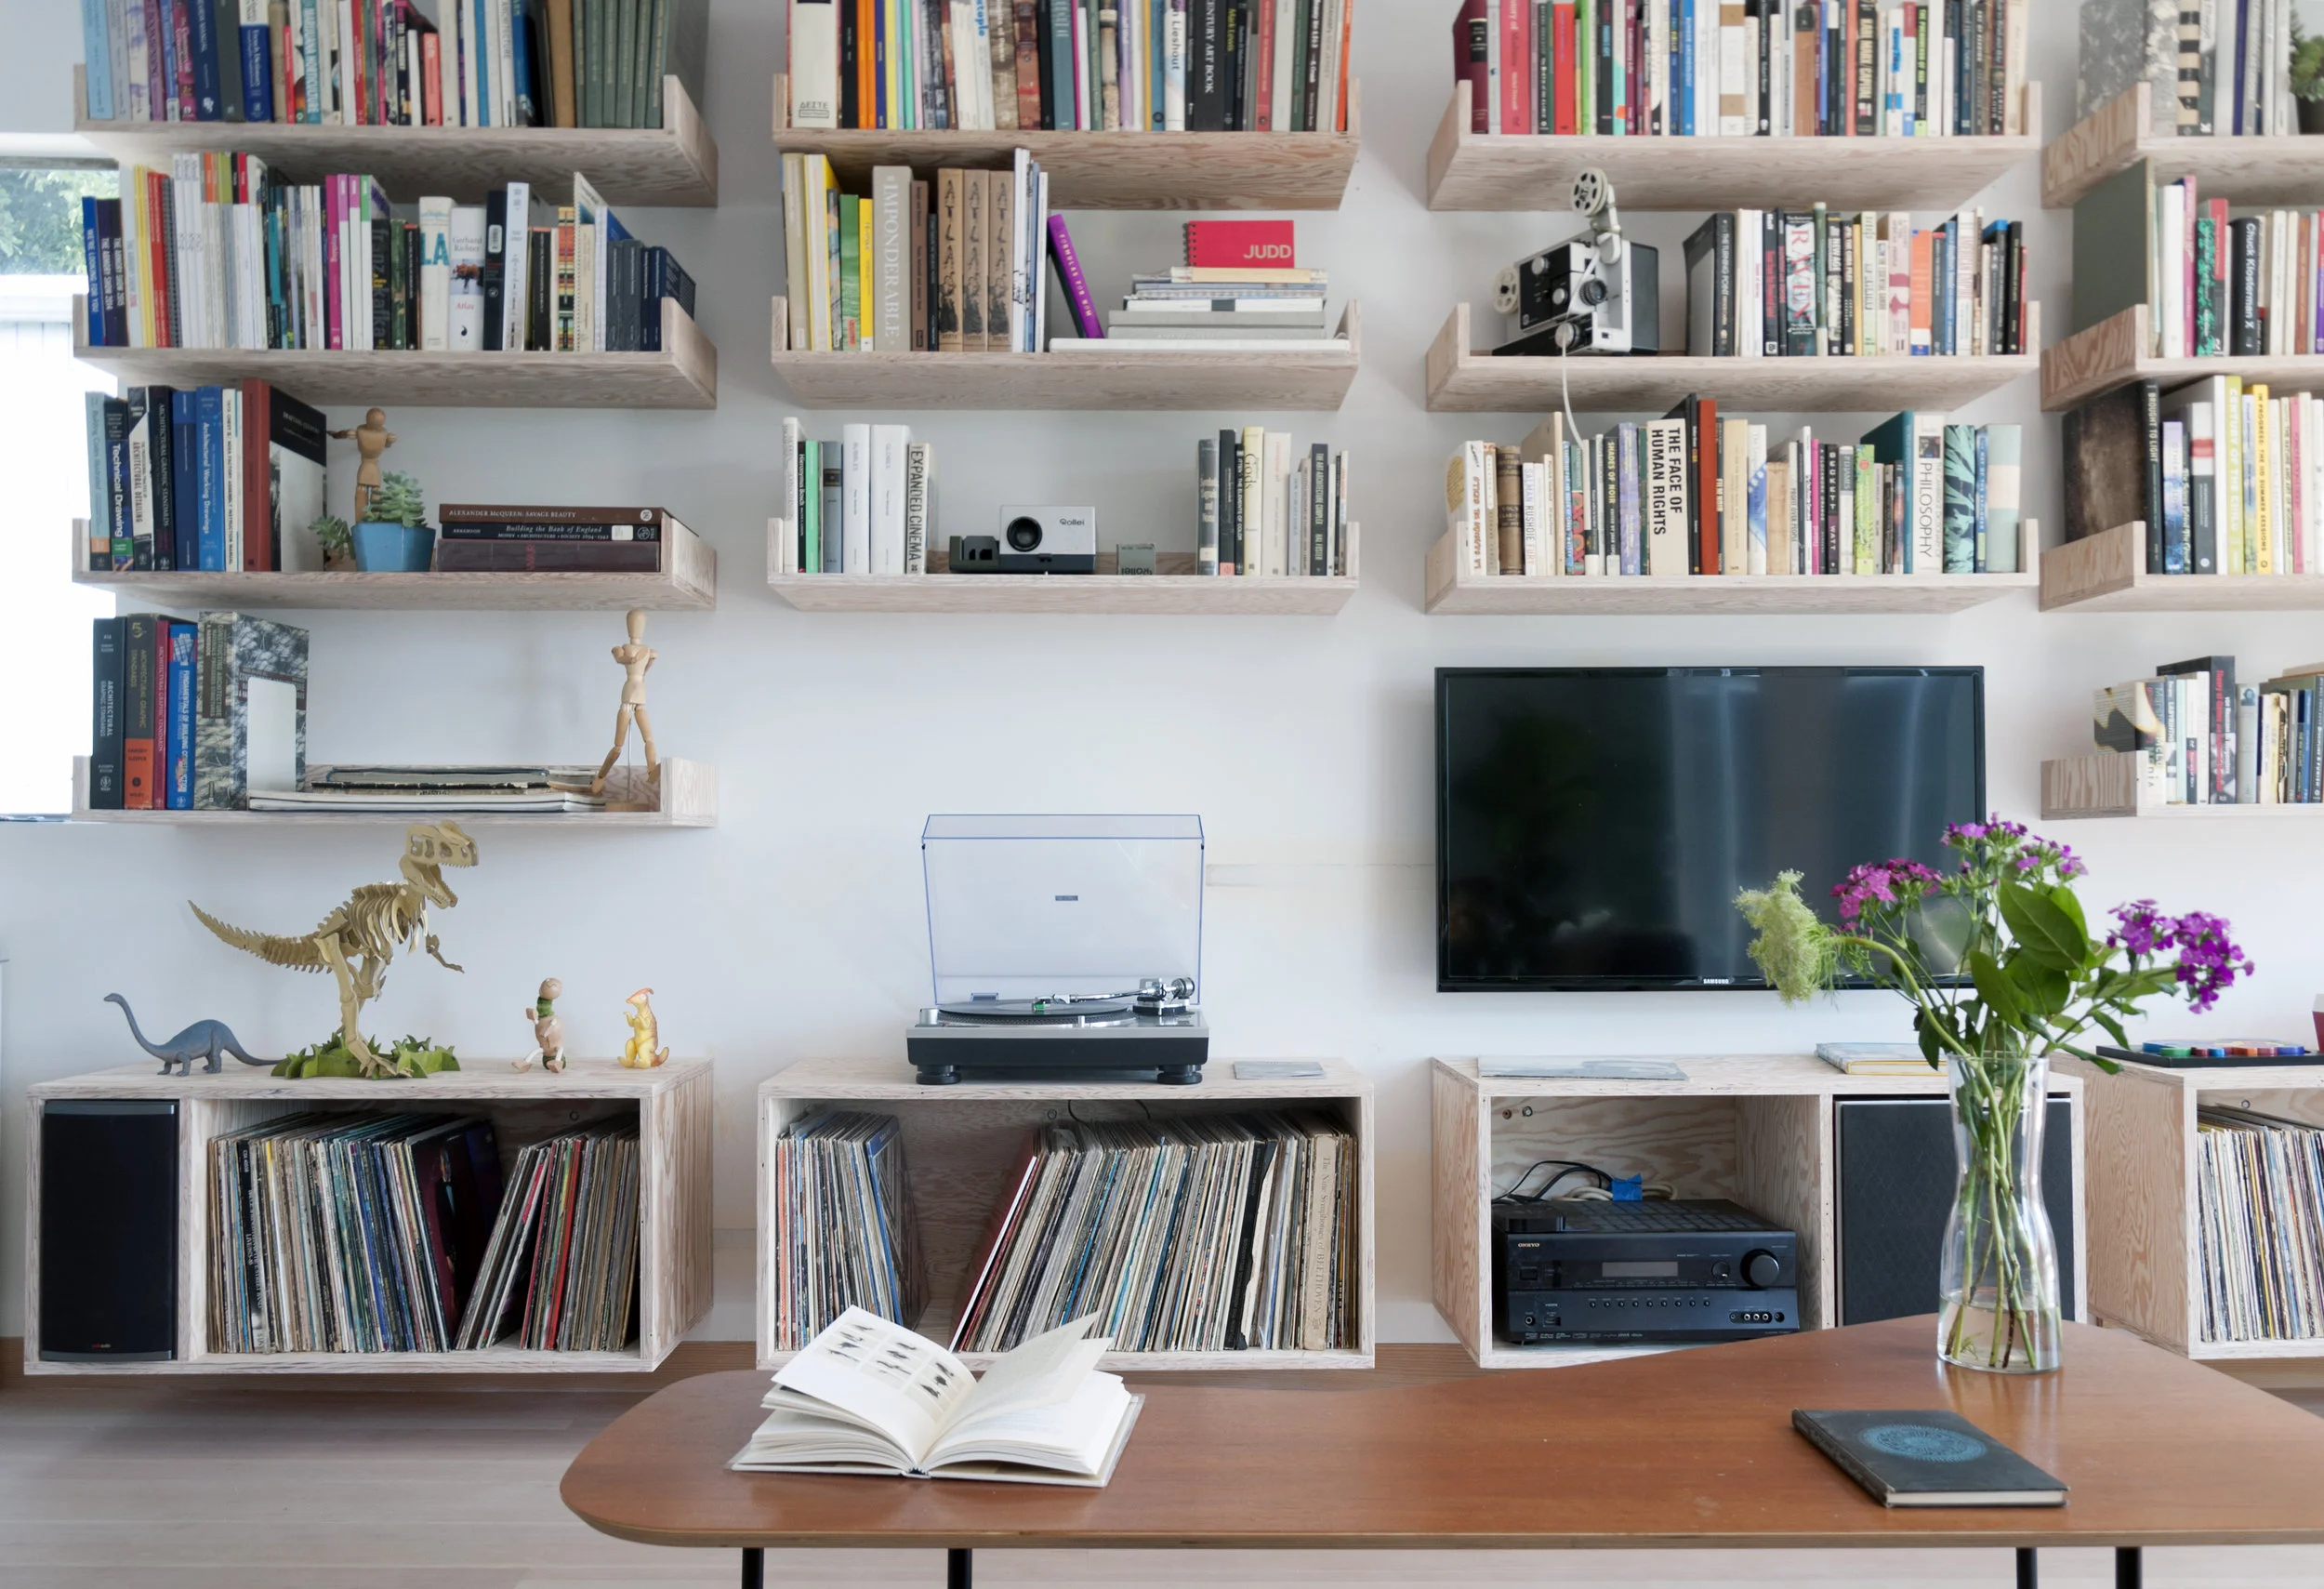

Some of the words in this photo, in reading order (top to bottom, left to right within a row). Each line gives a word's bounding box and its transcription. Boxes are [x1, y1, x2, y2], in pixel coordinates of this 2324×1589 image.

[303, 7, 316, 54] MARIJUANA
[502, 2, 511, 60] ARCHITECTURE
[1227, 8, 1236, 28] Mark
[1858, 19, 1872, 39] KARL
[1171, 20, 1184, 70] Lieshout
[1205, 43, 1214, 63] ART
[305, 56, 320, 113] HORTICULTURE
[1205, 64, 1214, 93] BOOK
[87, 229, 96, 251] WE'RE
[101, 237, 110, 249] THE
[113, 237, 123, 249] THE
[419, 232, 450, 266] LA
[1243, 245, 1292, 259] JUDD
[2244, 223, 2256, 257] Chuck
[102, 250, 112, 275] ARMORY
[114, 249, 123, 273] ARMORY
[883, 183, 900, 337] IMPONDERABLE
[1058, 233, 1078, 277] FORMULAS
[1075, 280, 1086, 296] FOR
[102, 277, 112, 294] SHOW
[115, 274, 124, 291] SHOW
[1790, 230, 1812, 320] RAVEN
[2244, 258, 2255, 318] Klosterman
[90, 283, 99, 297] FOR
[104, 295, 113, 311] 2014
[91, 298, 99, 312] YOU
[372, 287, 390, 338] kafka
[2244, 320, 2254, 329] X
[2148, 392, 2158, 428] BROUGHT
[2229, 388, 2238, 445] CENTURY
[158, 403, 167, 456] ARCHITECTURAL
[1669, 428, 1681, 454] THE
[2149, 430, 2158, 439] TO
[202, 422, 211, 467] Architectural
[1315, 453, 1324, 461] THE
[1651, 429, 1664, 480] HUMAN
[2149, 440, 2159, 463] LIGHT
[2229, 448, 2238, 465] OF
[112, 443, 123, 492] Technical
[132, 442, 142, 489] ARCHITECTURAL
[160, 457, 168, 487] GRAPHIC
[1243, 454, 1256, 490] Gods
[1608, 471, 1616, 482] OF
[1669, 457, 1682, 492] FACE
[2230, 469, 2239, 491] THE
[202, 469, 211, 498] Working
[908, 450, 924, 516] EXPANDED
[1525, 468, 1534, 502] SALMAN
[1608, 483, 1617, 504] NOIR
[113, 495, 125, 537] Drawing
[134, 491, 143, 523] DETAILING
[160, 487, 169, 526] STANDARDS
[203, 500, 212, 535] Drawings
[1237, 515, 1243, 523] OF
[1315, 504, 1324, 525] COMPLEX
[1653, 485, 1666, 536] RIGHTS
[1670, 497, 1683, 513] OF
[1919, 463, 1933, 558] PHILOSOPHY
[2231, 495, 2240, 532] CHILD
[566, 525, 574, 534] of
[576, 525, 602, 534] England
[1060, 518, 1086, 526] Rollei
[1525, 506, 1535, 541] RUSHDIE
[908, 519, 922, 562] CINEMA
[1314, 543, 1324, 561] FOSTER
[1315, 534, 1324, 543] HAL
[1526, 544, 1535, 565] FURY
[1322, 1156, 1331, 1172] The
[1321, 1174, 1330, 1192] Nine
[1316, 1194, 1327, 1240] Symphonies
[1313, 1253, 1326, 1313] BEETHOVEN
